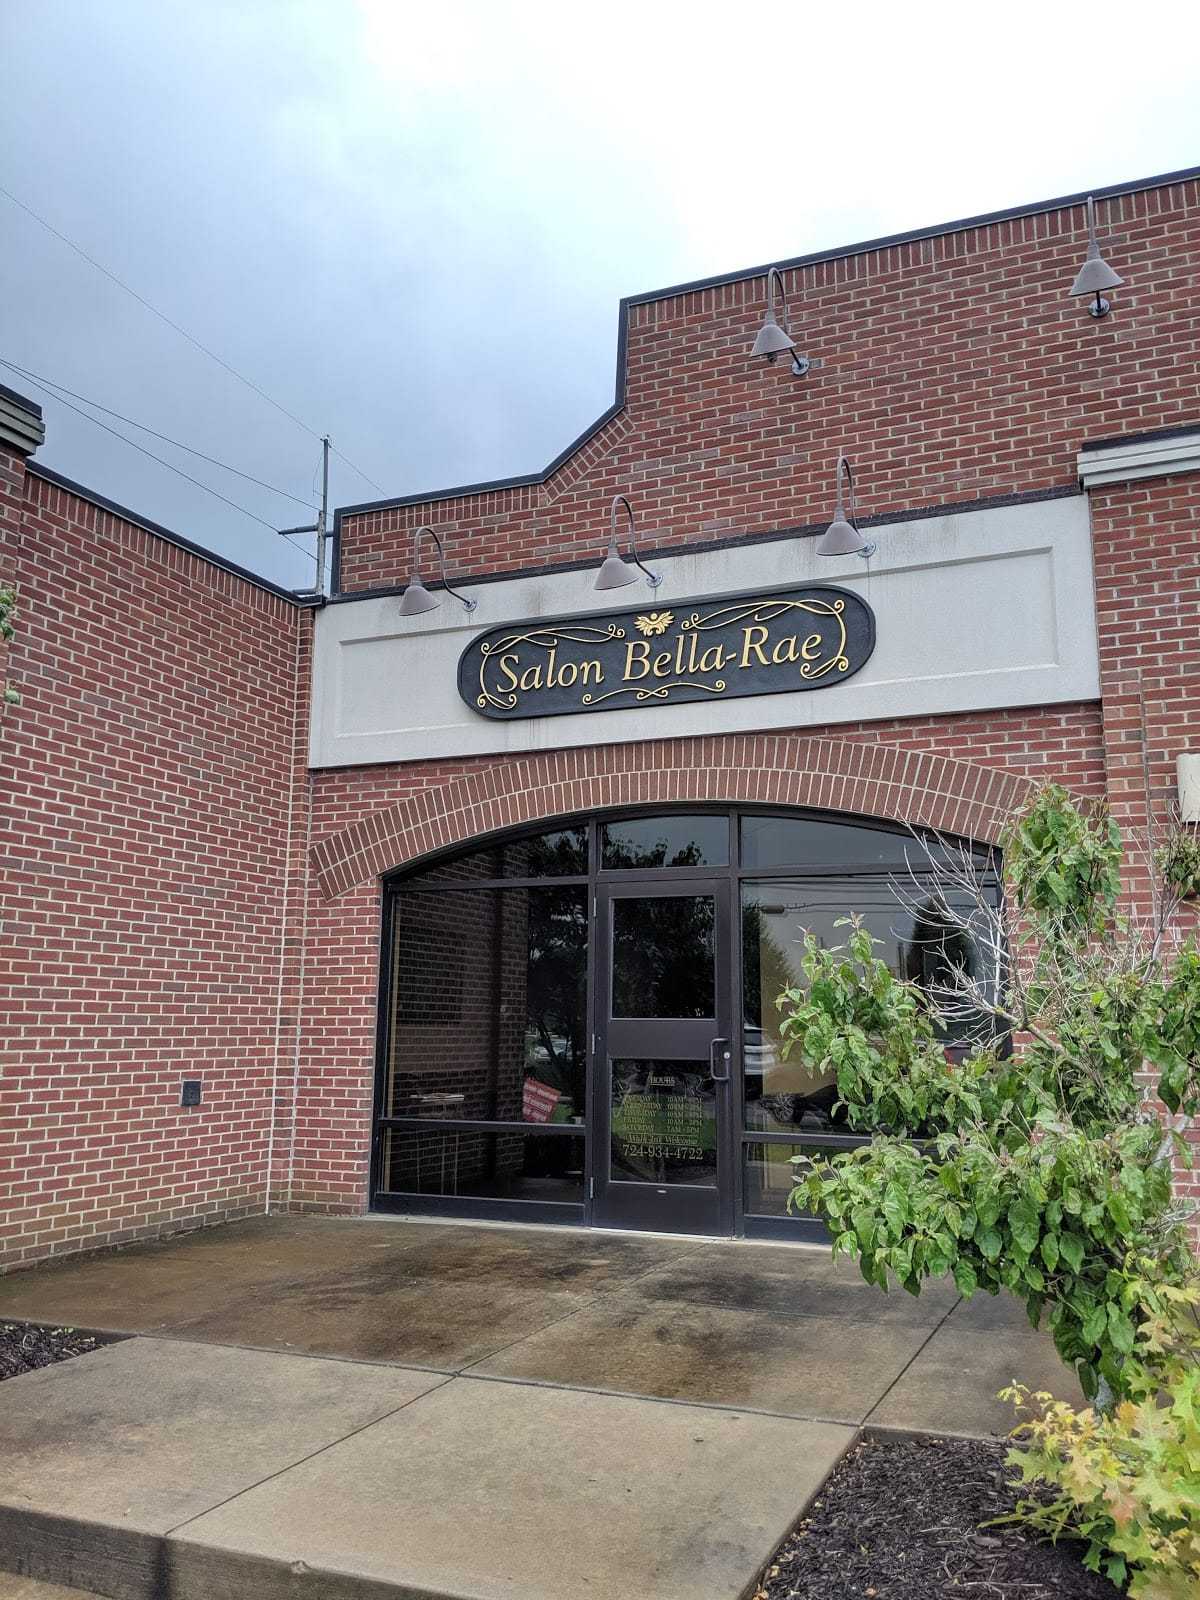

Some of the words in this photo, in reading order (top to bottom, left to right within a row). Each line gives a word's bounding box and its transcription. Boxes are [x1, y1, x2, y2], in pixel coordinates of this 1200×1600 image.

[496, 648, 605, 694] Salon
[621, 625, 823, 682] Bella-Rae
[622, 1144, 704, 1160] 724-934-4722
